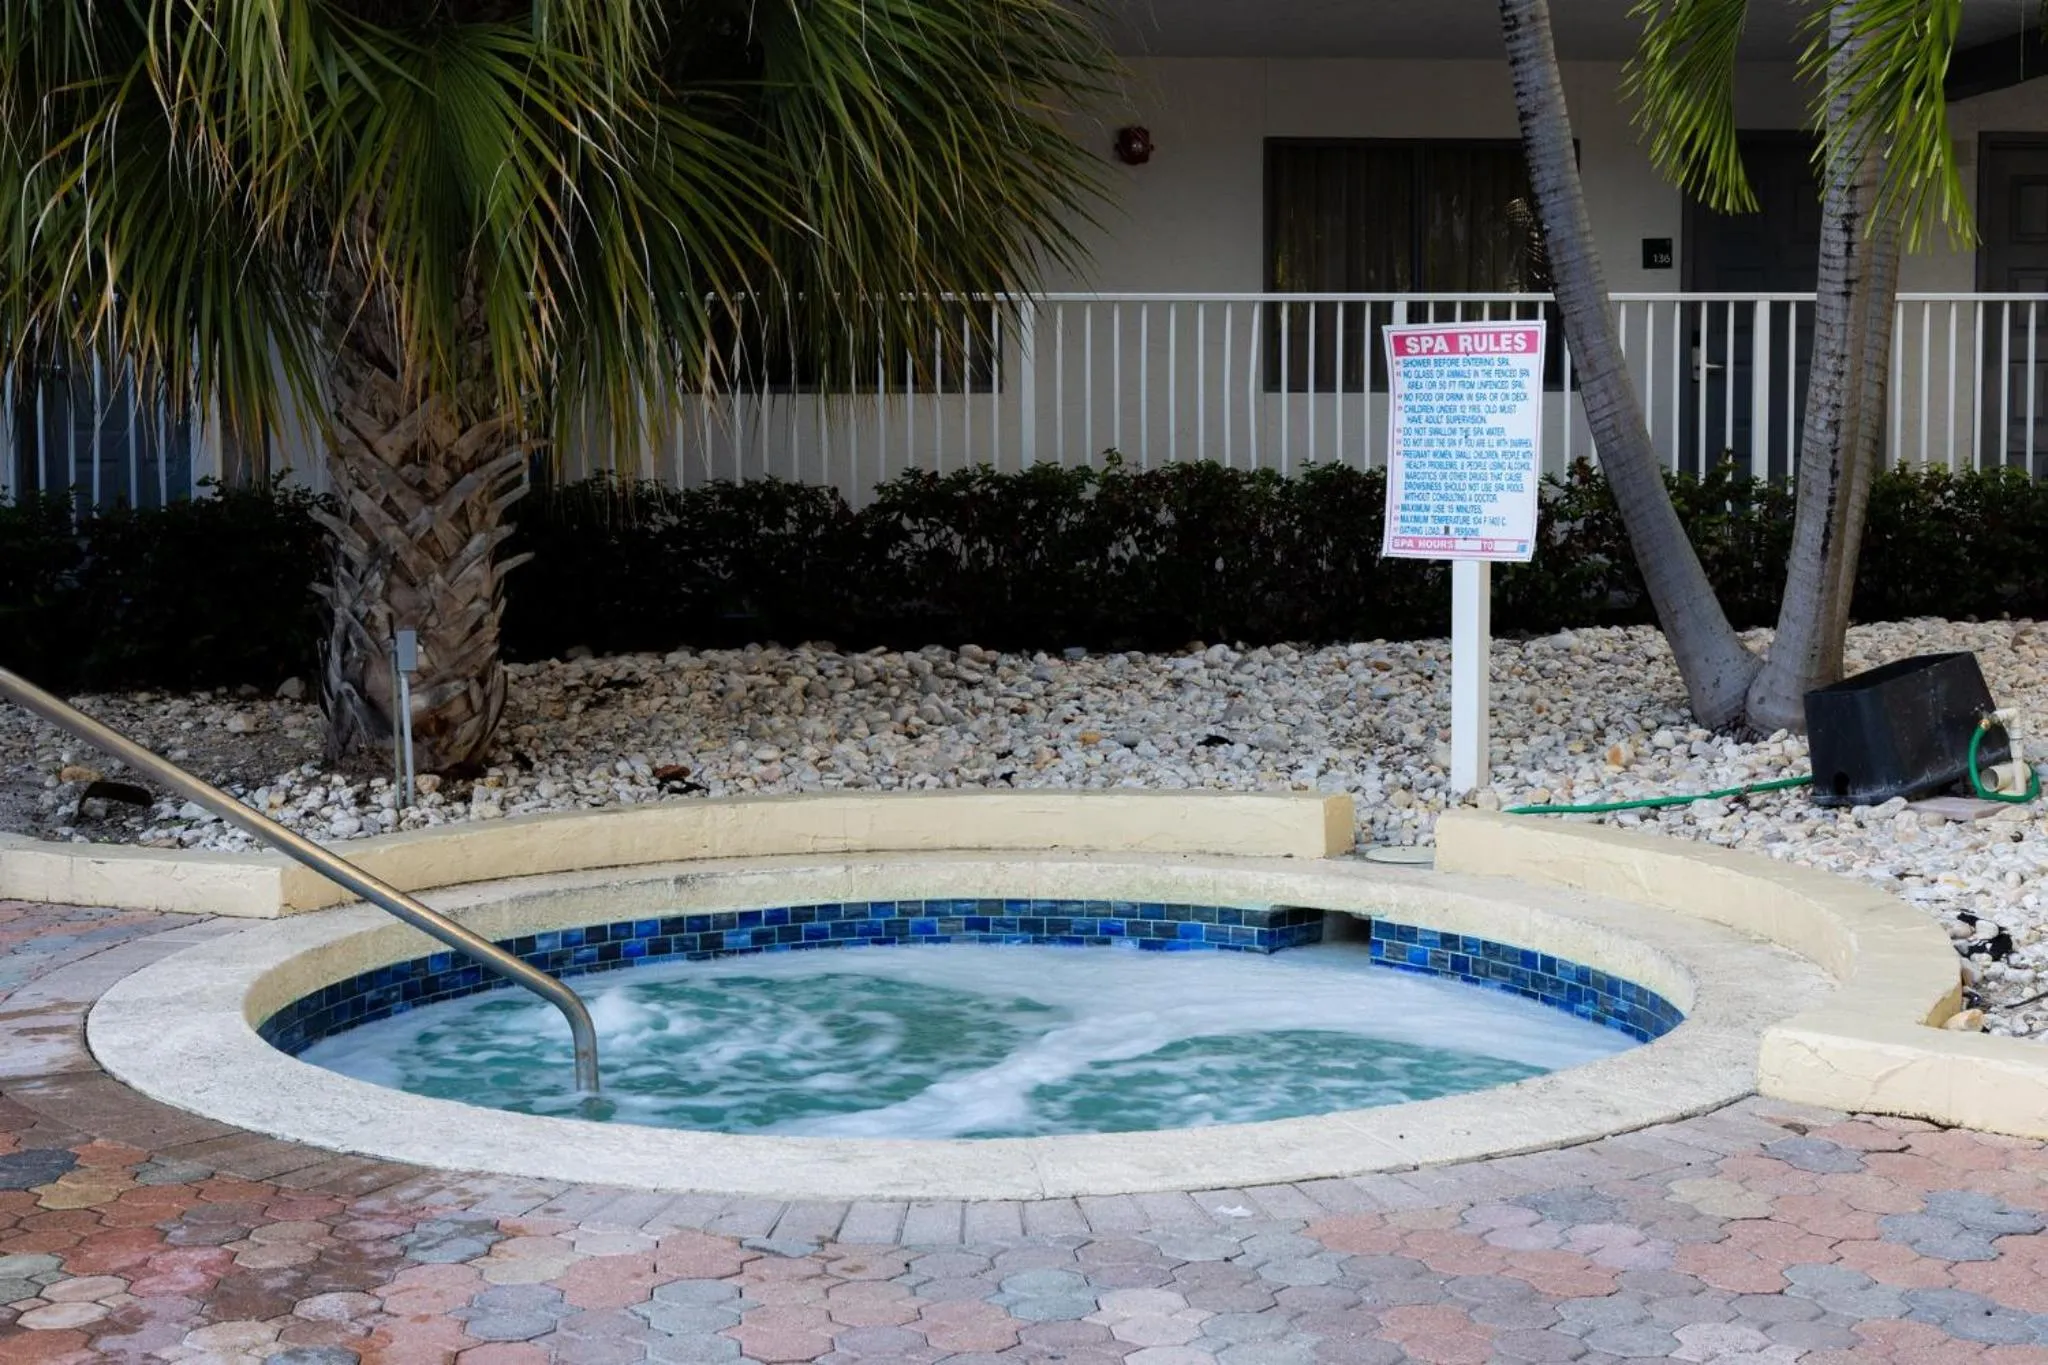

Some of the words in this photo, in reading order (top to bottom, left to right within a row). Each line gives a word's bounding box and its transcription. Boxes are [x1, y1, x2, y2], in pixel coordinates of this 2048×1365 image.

[1405, 336, 1450, 354] SPA
[1458, 333, 1527, 352] RULES
[1434, 358, 1459, 367] BEFORE
[1414, 369, 1434, 378] GLASS
[1481, 369, 1492, 378] THE
[1408, 381, 1422, 389] AREA
[1458, 381, 1475, 389] FROM
[1416, 393, 1432, 401] FOOD
[1446, 393, 1463, 401] DRINK
[1475, 393, 1487, 401] SPA
[1404, 405, 1434, 413] CHILDREN
[1436, 405, 1457, 413] UNDER
[1484, 405, 1497, 413] OLD
[1499, 404, 1516, 413] MUST
[1408, 415, 1422, 424] HAVE
[1425, 415, 1444, 424] ADULT
[1414, 427, 1426, 435] NOT
[1429, 427, 1456, 436] SWALLOW
[1473, 427, 1484, 436] SPA
[1444, 482, 1466, 491] SHOULD
[1401, 504, 1430, 512] MAXIMUM
[1400, 515, 1428, 523] MAXIMUM
[1394, 539, 1414, 548] SPA
[1484, 542, 1492, 550] TO
